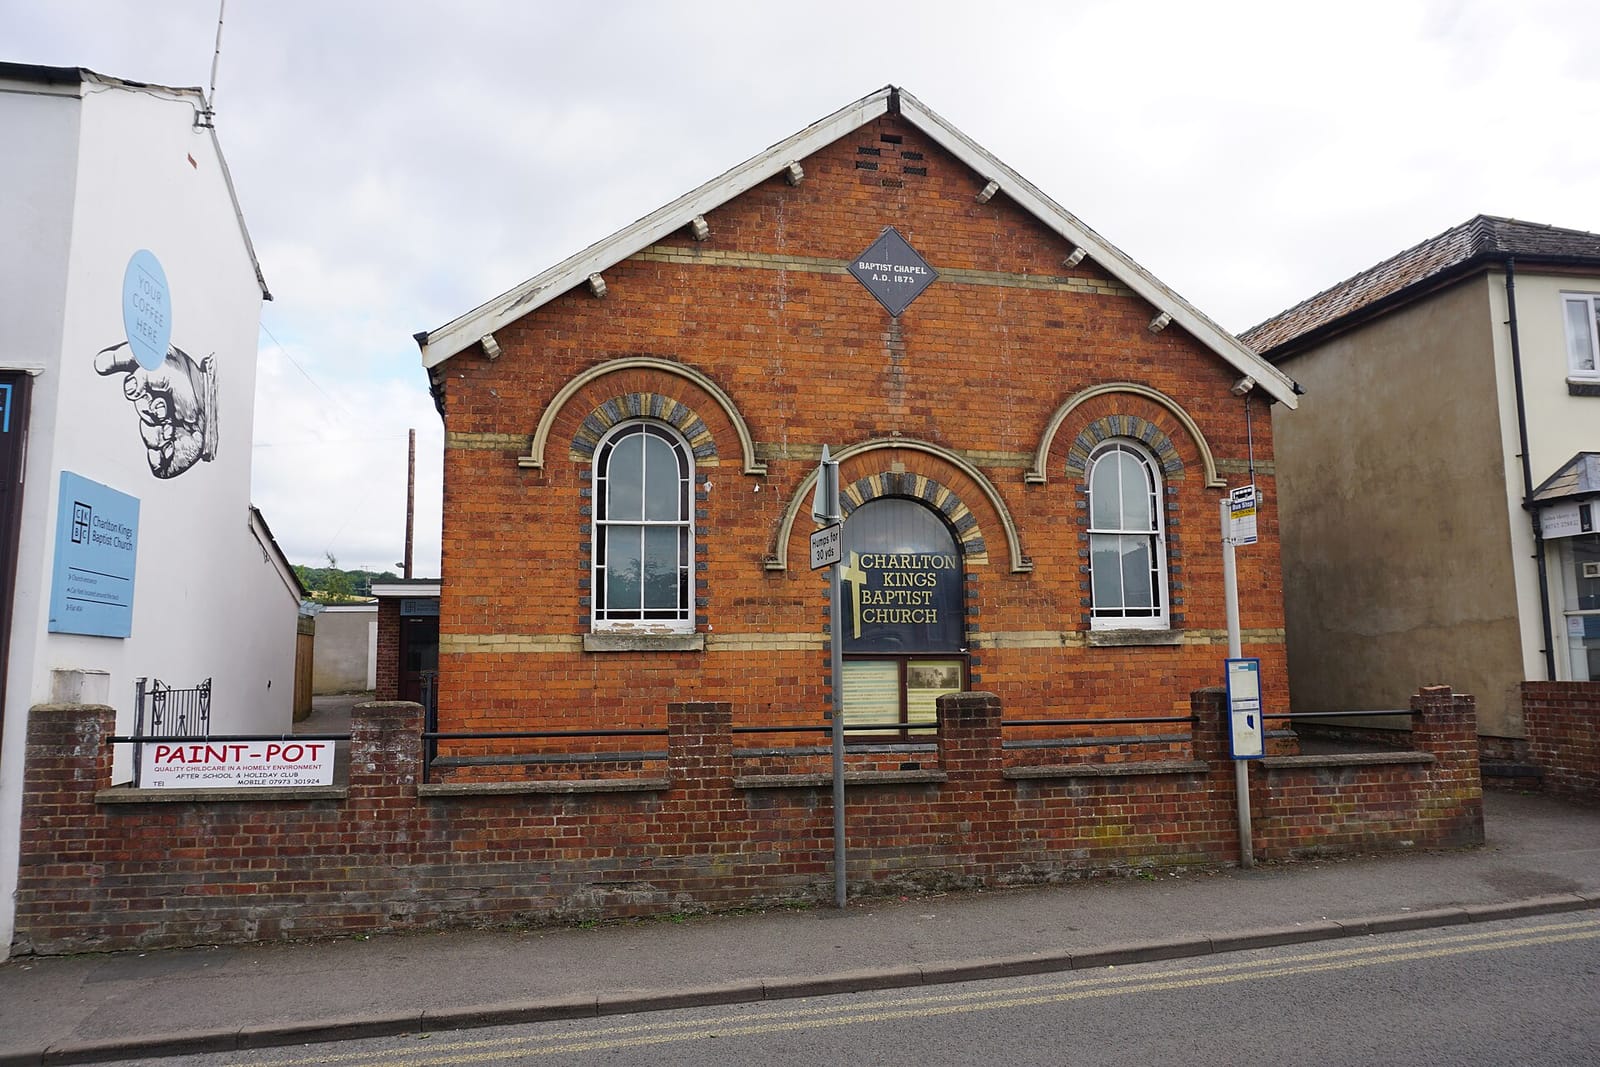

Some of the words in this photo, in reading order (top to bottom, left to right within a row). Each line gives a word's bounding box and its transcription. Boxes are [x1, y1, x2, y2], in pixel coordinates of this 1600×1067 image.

[859, 262, 892, 271] BAPTIST
[894, 265, 927, 275] CHAPEL
[872, 273, 891, 281] A.D.
[894, 275, 914, 284] 1875
[139, 275, 161, 304] YOUR
[133, 293, 164, 328] COFFEE
[136, 317, 158, 345] HERE
[92, 515, 118, 532] Charlton
[119, 523, 132, 540] Kings
[92, 530, 113, 548] Baptist
[113, 536, 133, 551] Church
[812, 536, 829, 548] Humps
[830, 531, 838, 543] for
[816, 549, 824, 561] 30
[825, 548, 834, 560] yds
[860, 554, 957, 570] CHARLTON
[883, 572, 937, 587] KINGS
[861, 590, 932, 605] BAPTIST
[862, 609, 937, 624] CHURCH
[155, 744, 325, 763] PAINT-POT
